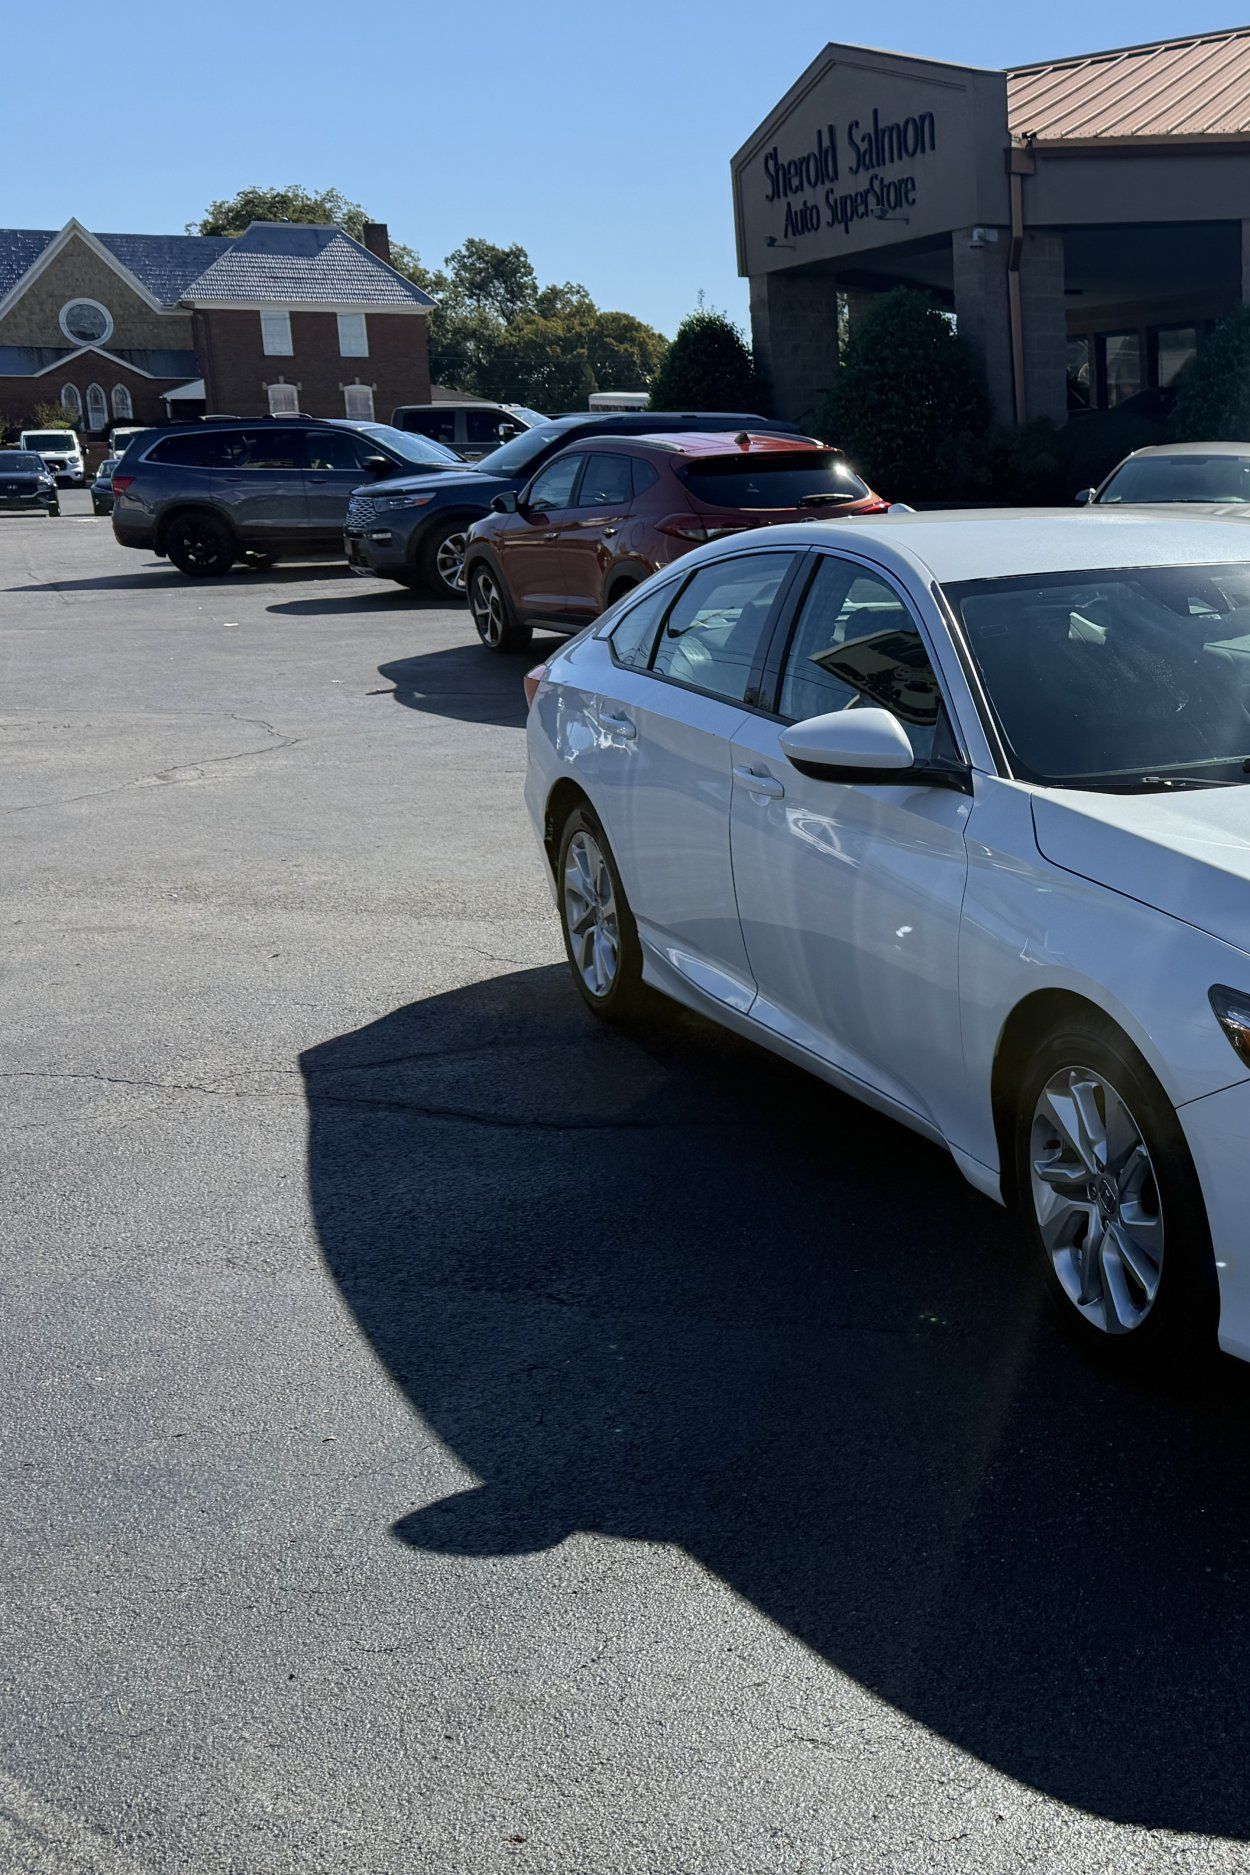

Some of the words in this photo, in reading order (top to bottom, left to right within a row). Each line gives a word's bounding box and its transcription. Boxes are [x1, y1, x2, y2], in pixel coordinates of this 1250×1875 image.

[764, 124, 838, 202] Sherold
[847, 108, 936, 175] Salmon
[784, 201, 820, 239] Auto
[826, 175, 916, 234] SuperStore
